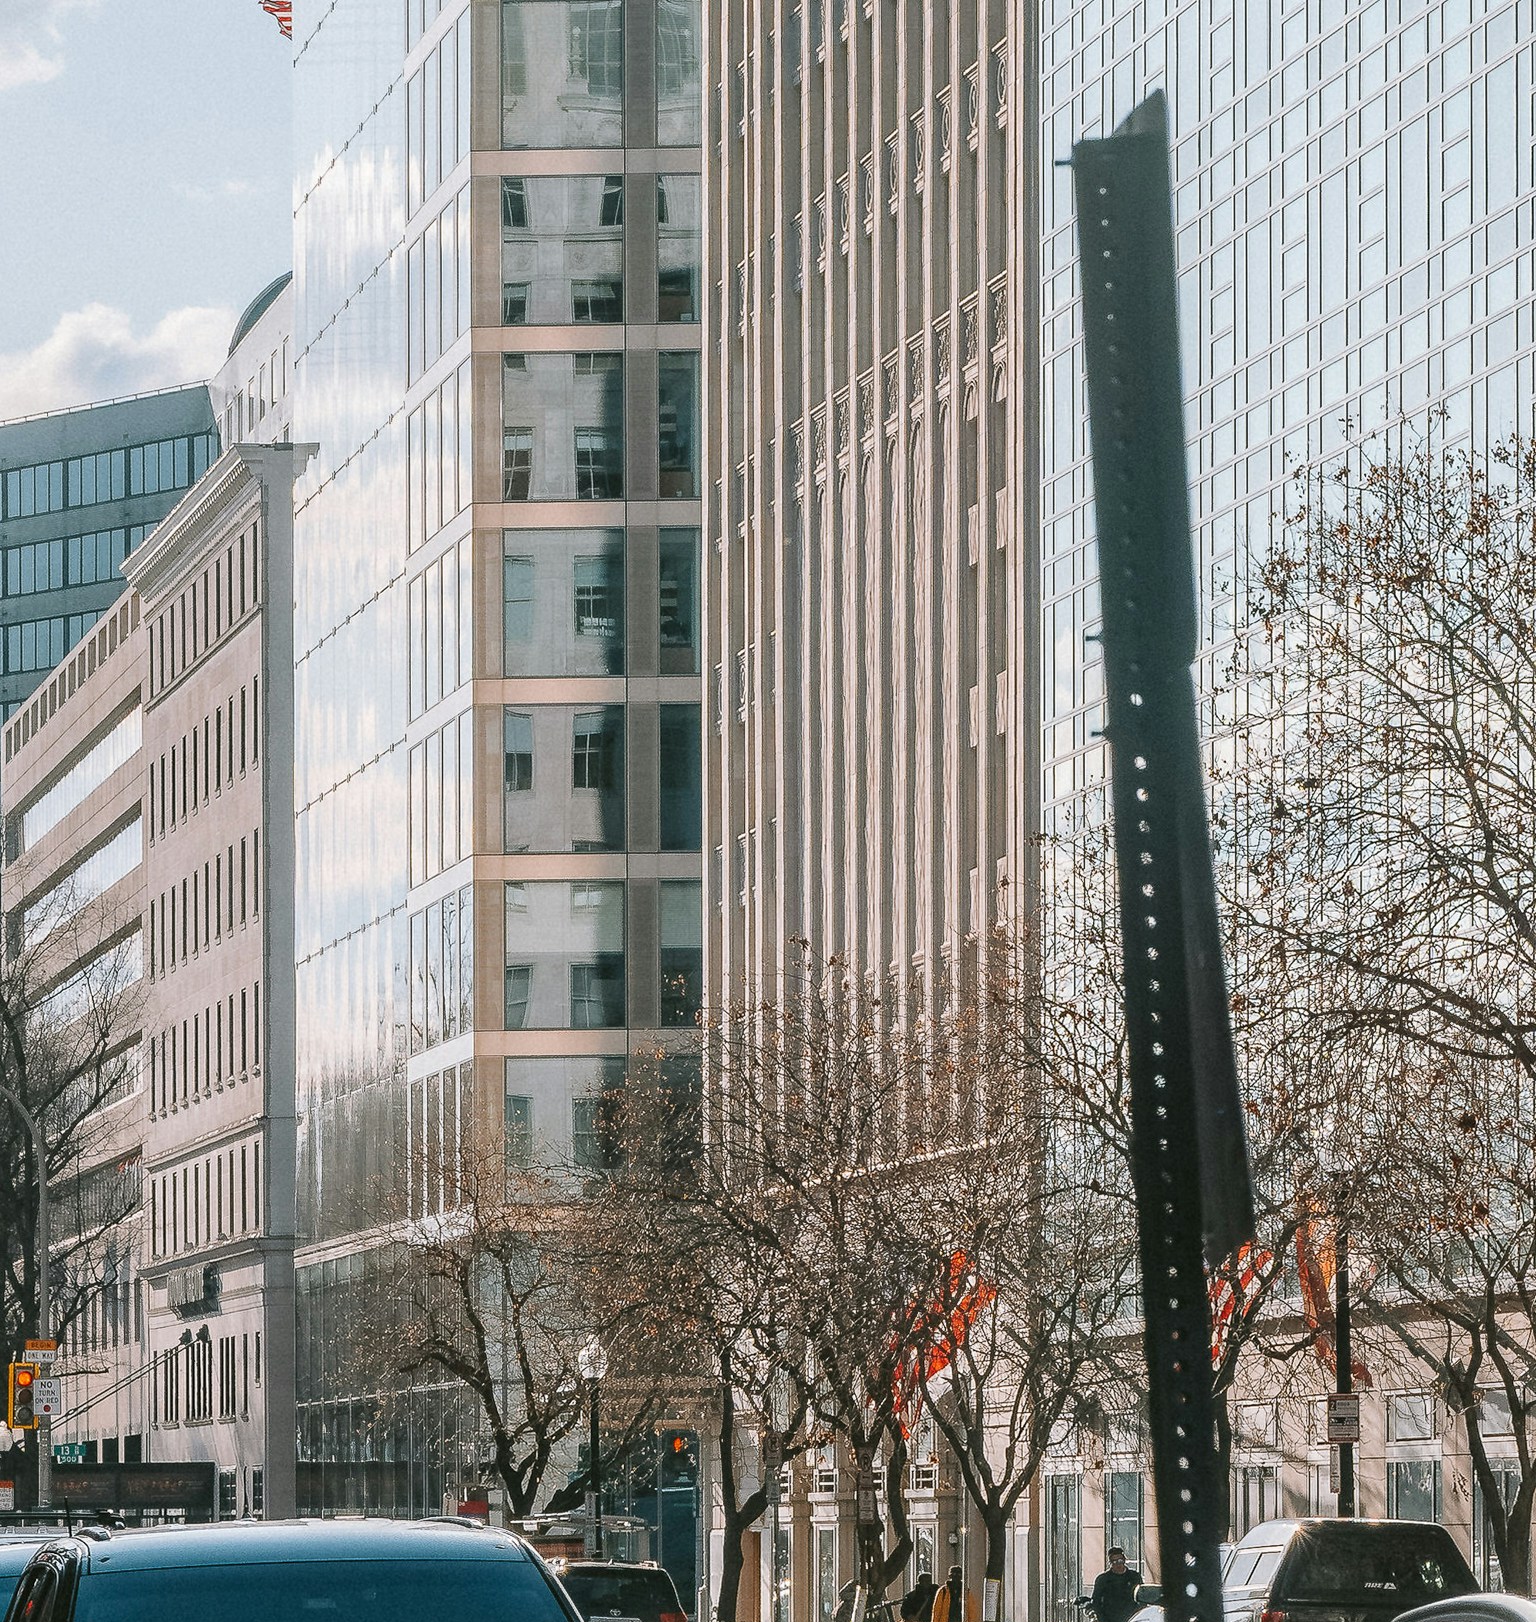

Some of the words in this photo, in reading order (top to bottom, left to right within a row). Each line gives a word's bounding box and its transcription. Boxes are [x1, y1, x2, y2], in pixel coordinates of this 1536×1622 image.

[42, 1351, 54, 1360] WAY
[40, 1381, 53, 1389] NO
[61, 1446, 69, 1456] 13
